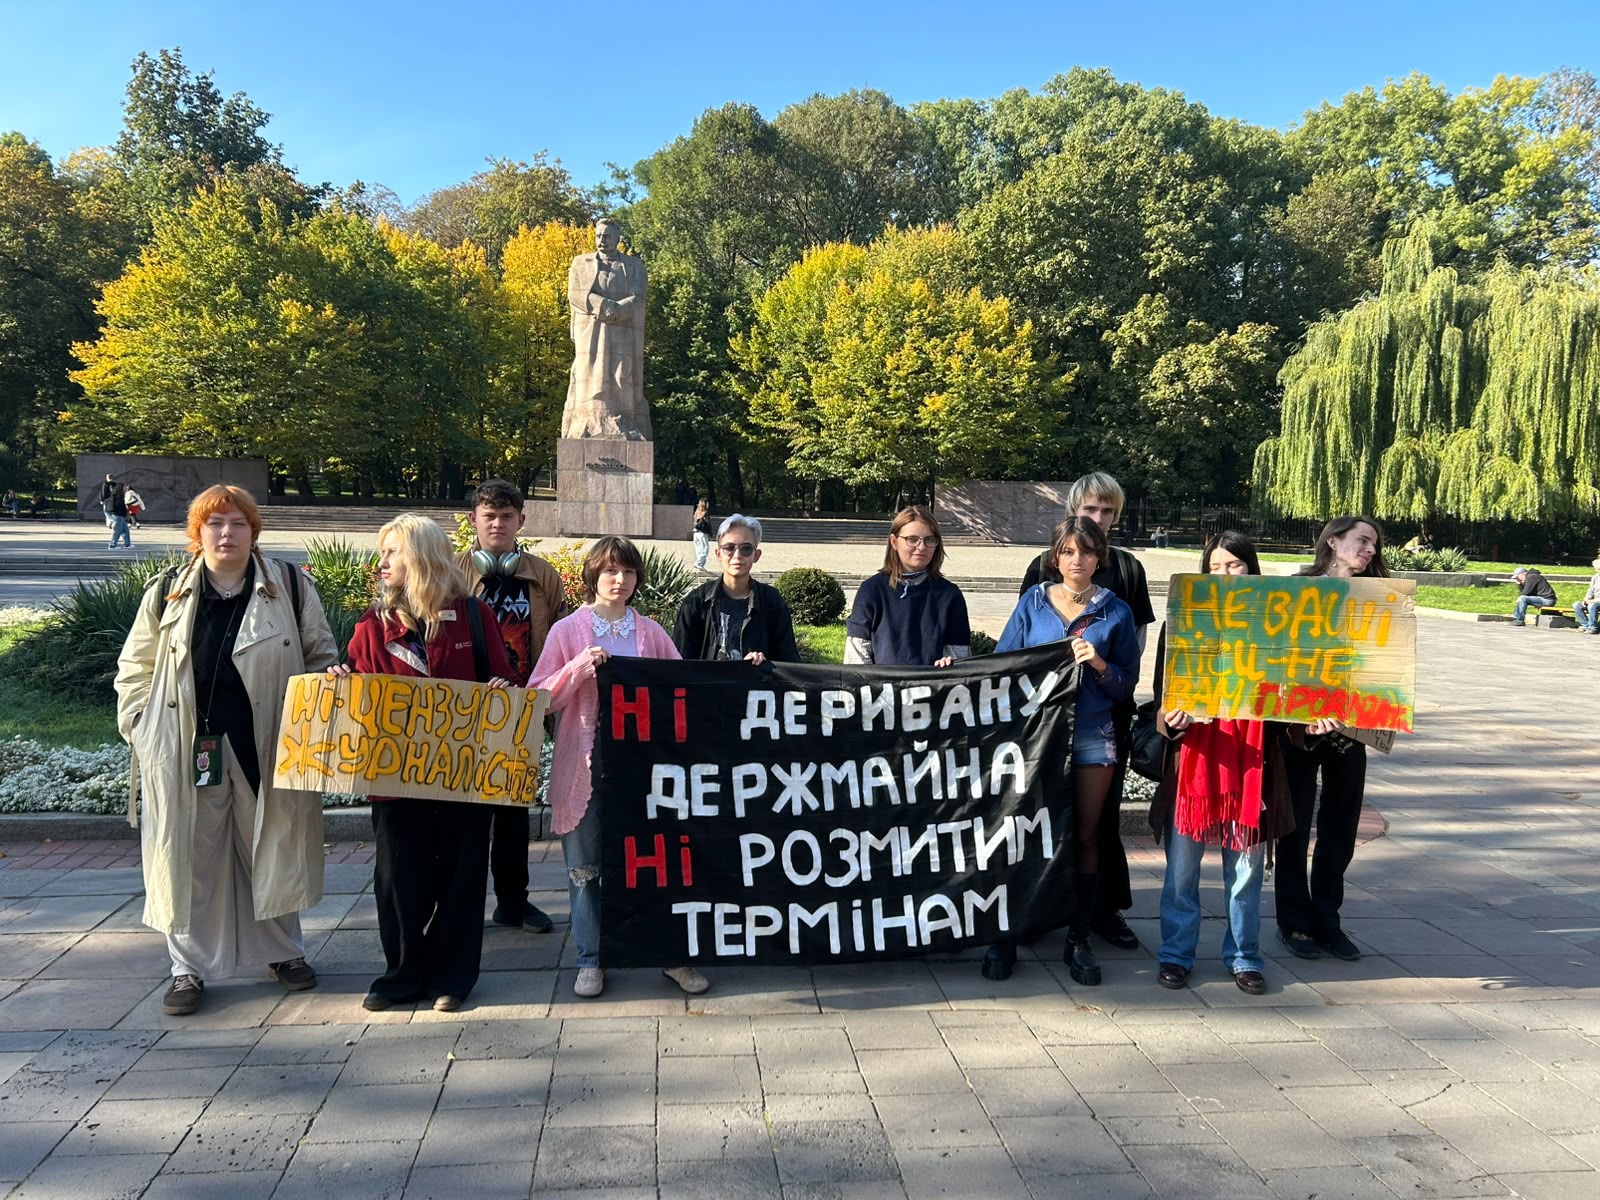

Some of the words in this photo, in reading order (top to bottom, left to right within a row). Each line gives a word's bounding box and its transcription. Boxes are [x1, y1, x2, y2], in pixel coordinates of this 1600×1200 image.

[1181, 577, 1251, 632] НЕ
[611, 684, 687, 743] Ні
[740, 671, 1058, 741] ДЕРИБАНУ
[646, 740, 1026, 820] ДЕРЖМАЙНА
[624, 833, 693, 889] Ні
[739, 807, 1054, 888] РОЗМИТИМ
[671, 884, 1010, 957] ТЕРМіНАМ
